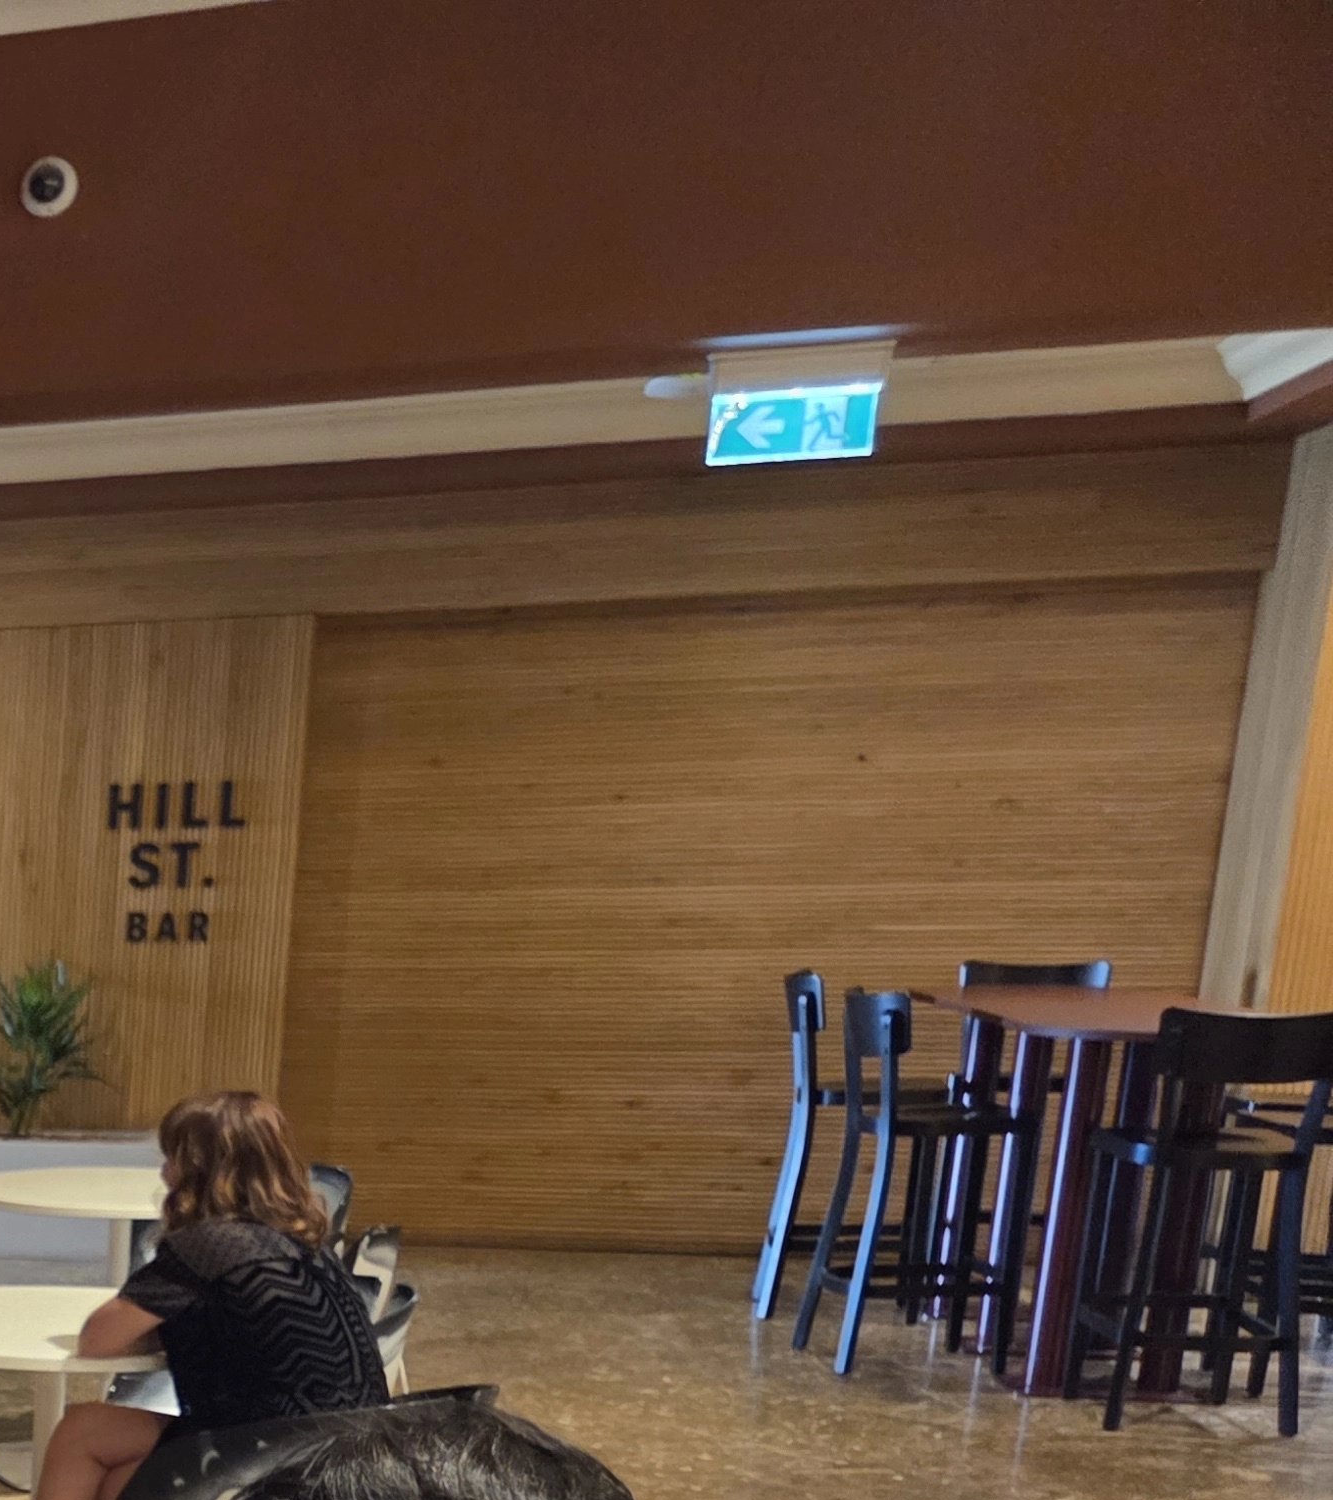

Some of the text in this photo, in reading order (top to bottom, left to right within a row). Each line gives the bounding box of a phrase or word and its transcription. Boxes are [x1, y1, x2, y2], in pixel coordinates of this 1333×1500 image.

[108, 781, 246, 829] HILL
[129, 842, 213, 889] ST.
[126, 912, 209, 942] BAR
